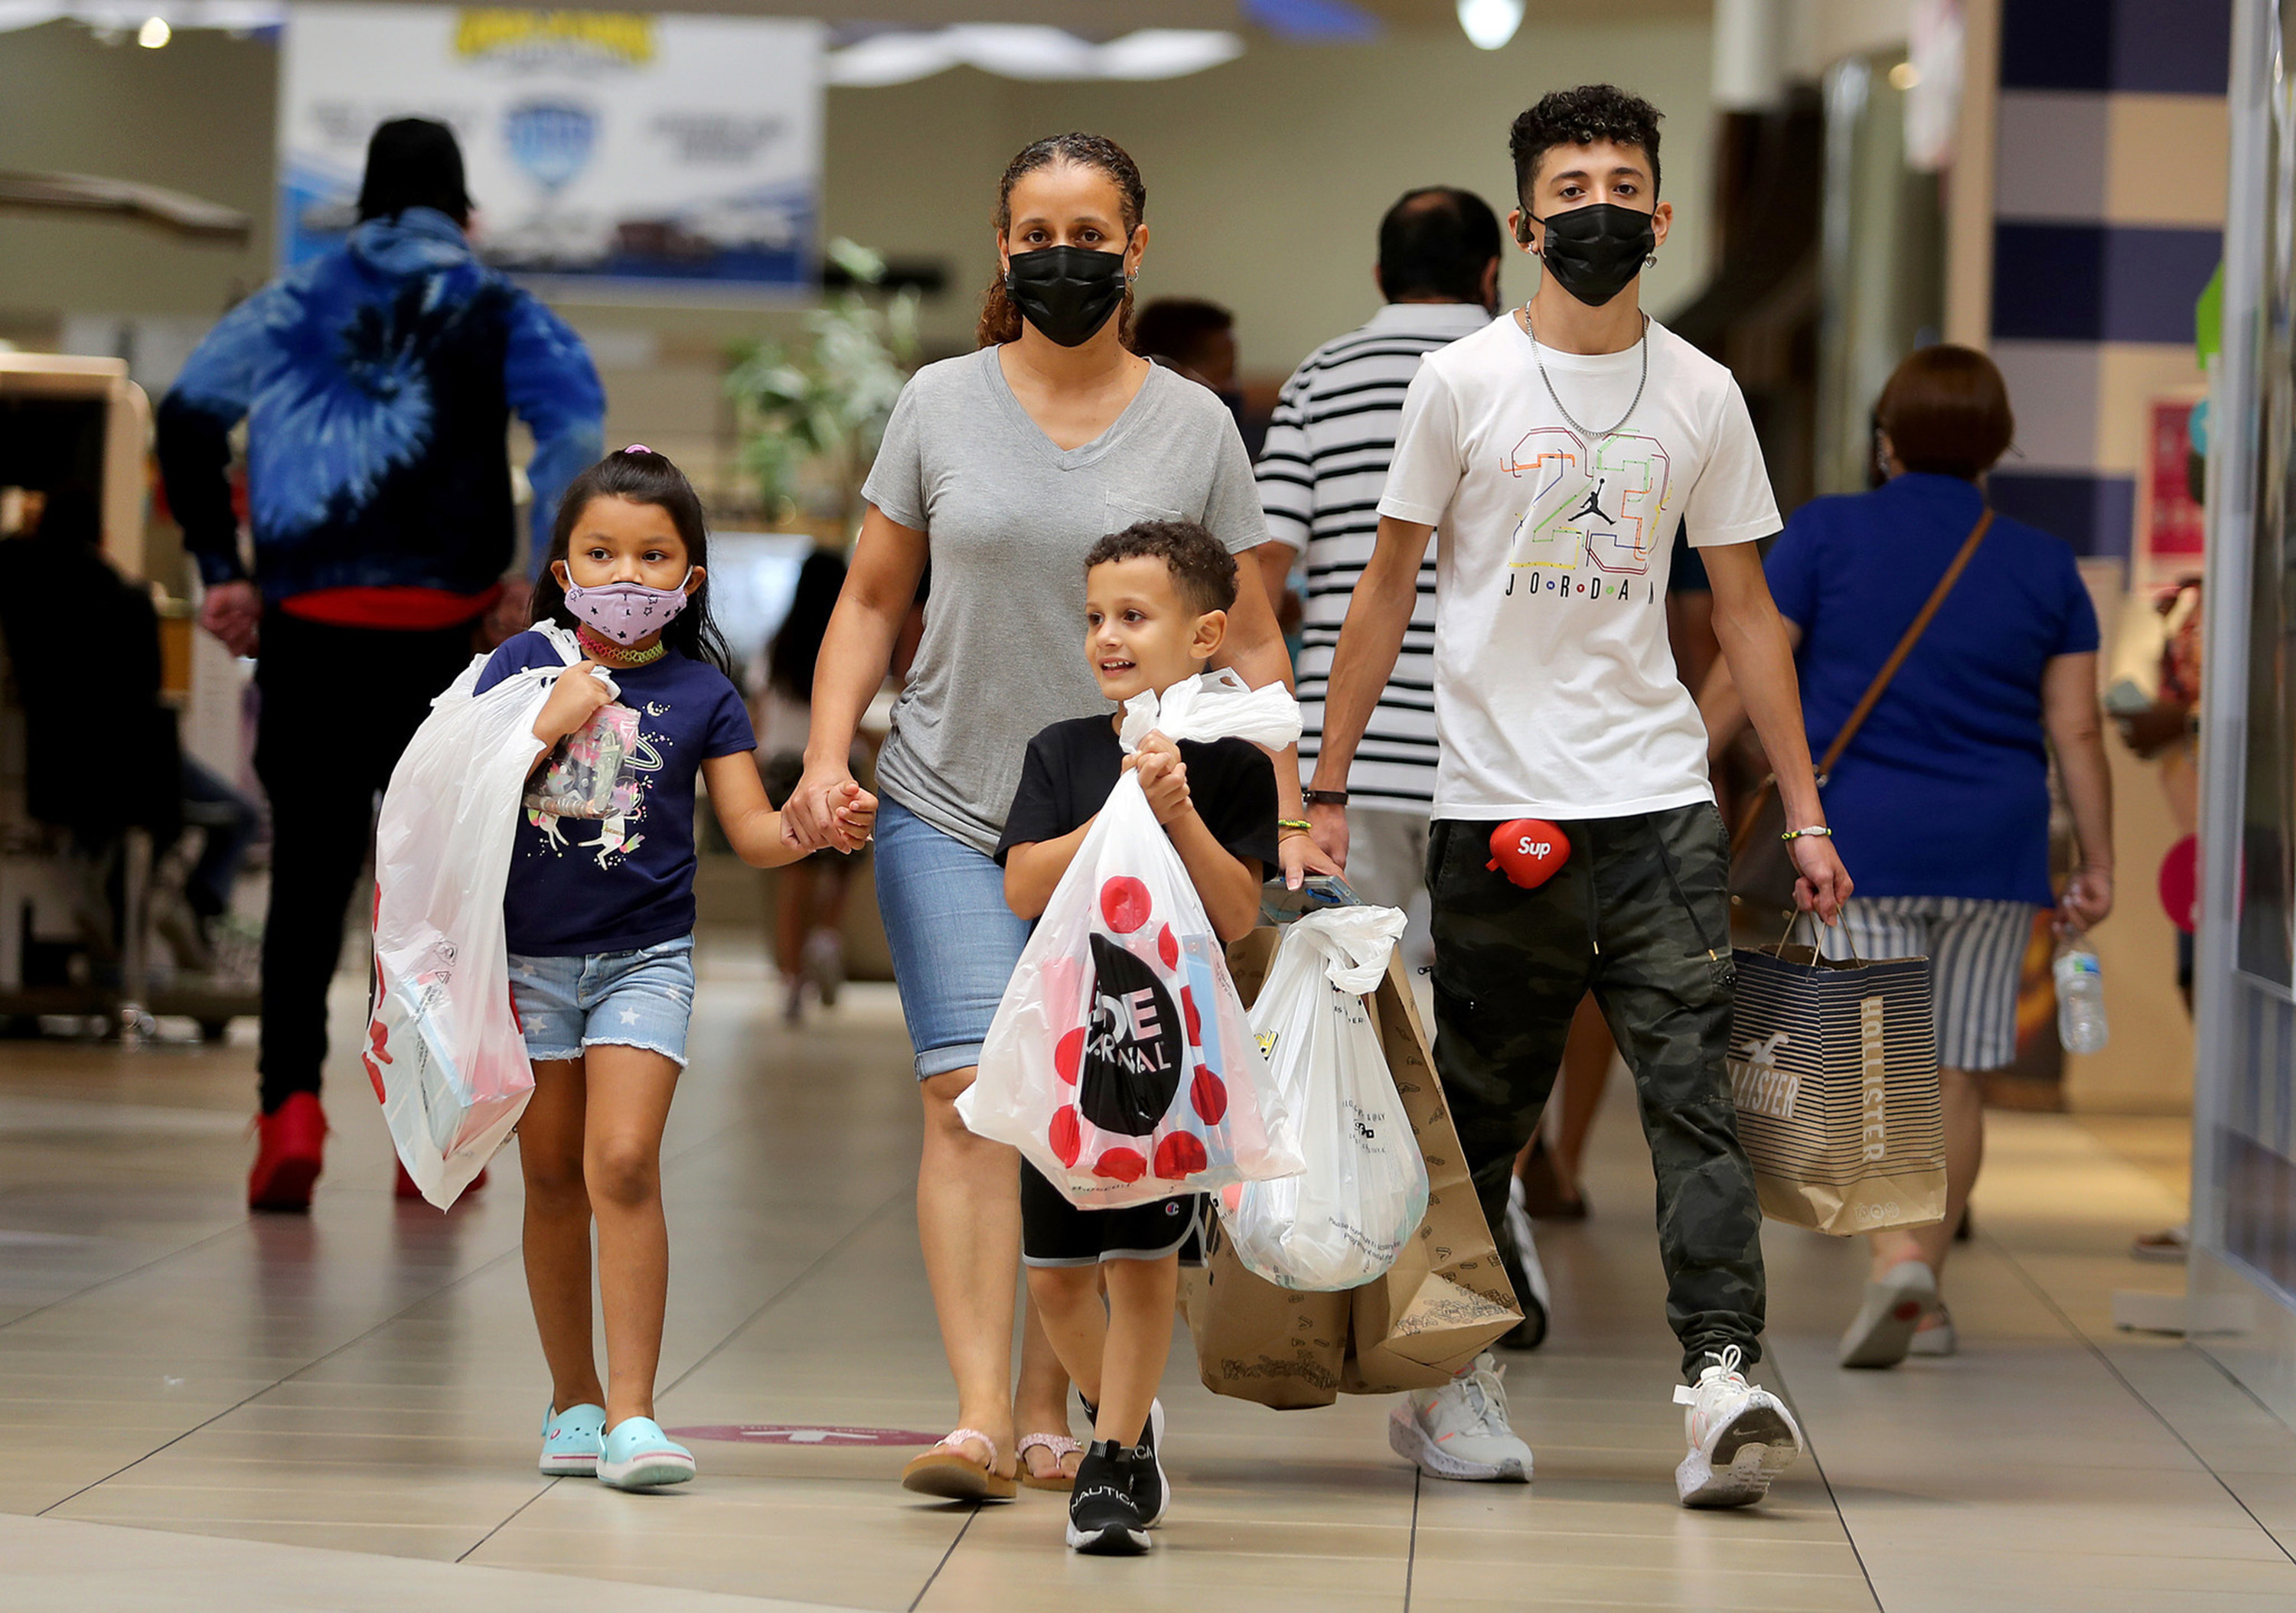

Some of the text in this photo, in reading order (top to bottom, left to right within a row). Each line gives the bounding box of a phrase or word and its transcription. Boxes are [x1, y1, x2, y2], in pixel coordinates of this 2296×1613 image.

[1518, 836, 1551, 860] Sup
[1861, 999, 1885, 1164] HOLLISTER
[1071, 1485, 1140, 1514] NAUTICA
